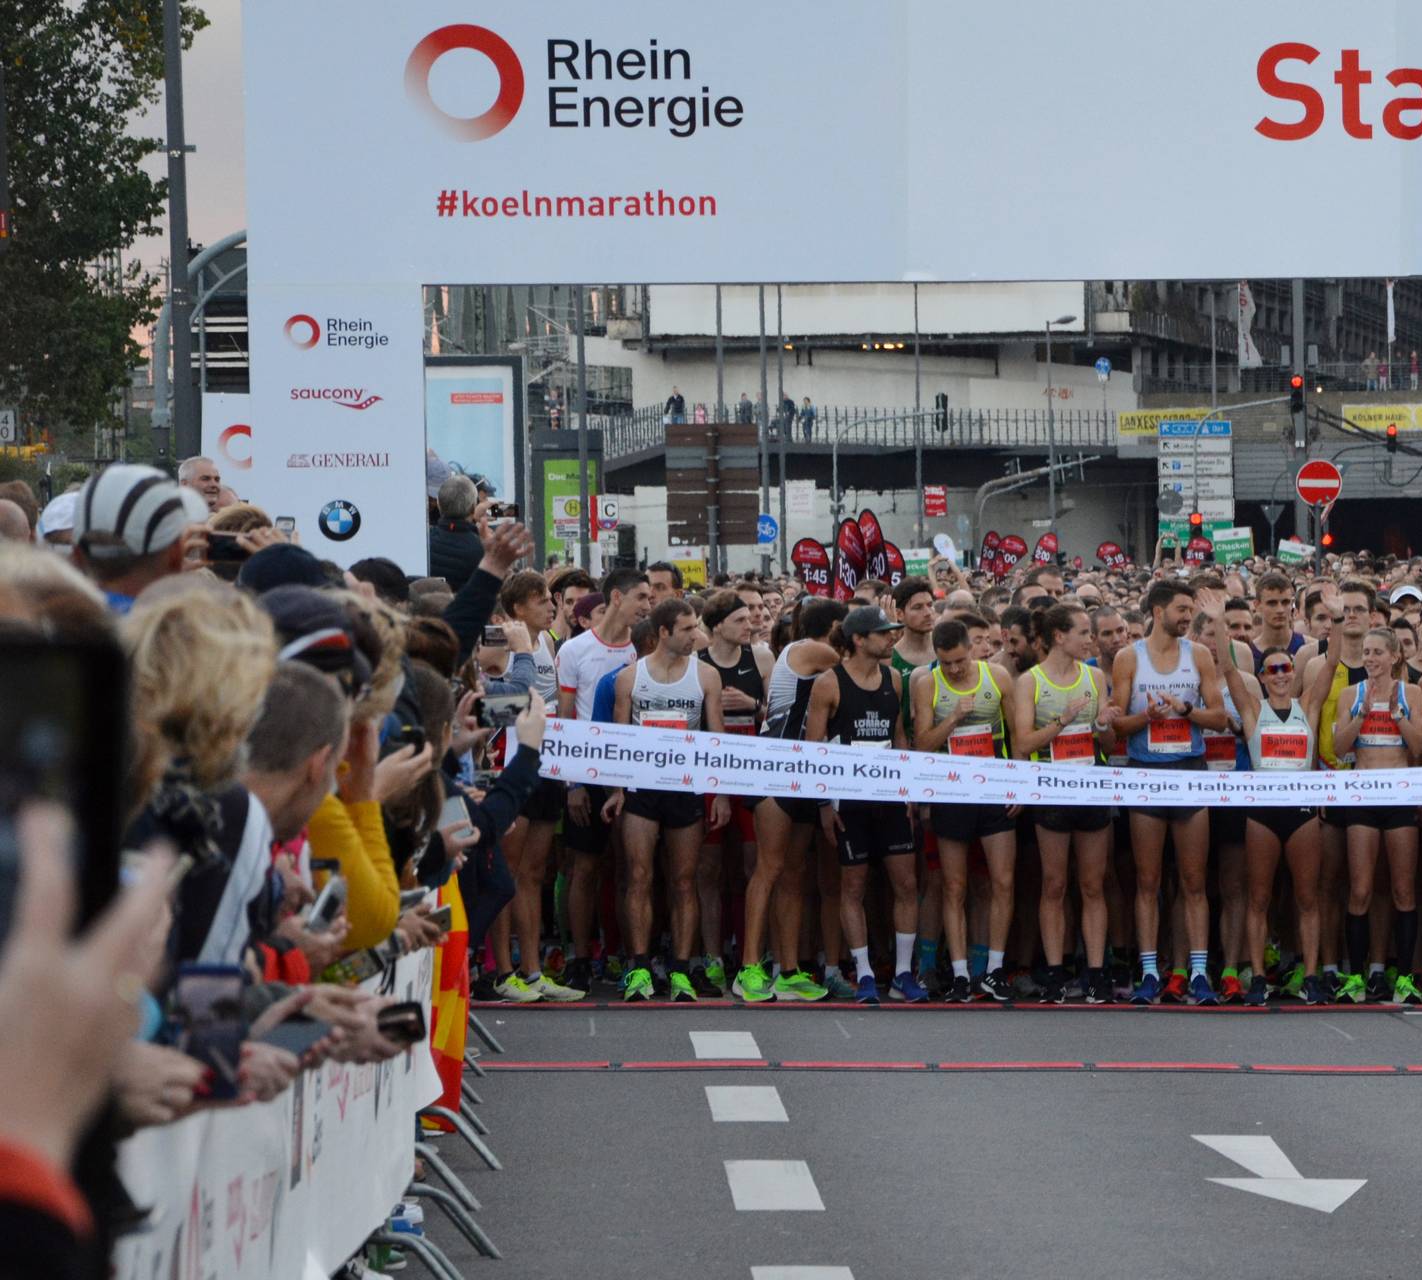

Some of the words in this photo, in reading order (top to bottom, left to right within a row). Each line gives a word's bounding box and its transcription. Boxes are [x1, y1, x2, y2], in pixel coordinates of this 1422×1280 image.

[548, 39, 691, 80] Rhein
[549, 87, 743, 137] Energie
[436, 189, 717, 217] #koelnmarathon
[327, 318, 373, 332] Rhein
[327, 333, 389, 350] Energie
[290, 388, 364, 402] saucony
[312, 453, 389, 467] GENERALI
[605, 503, 616, 517] C
[803, 569, 828, 584] 1:45
[640, 700, 649, 710] LT
[668, 700, 695, 709] DSHS
[1267, 735, 1304, 746] Sabrina
[541, 739, 686, 767] RheinEnergie
[694, 751, 844, 776] Halbmarathon
[852, 763, 900, 779] Köln
[1038, 776, 1179, 792] RheinEnergie
[1188, 779, 1336, 791] Halbmarathon
[1345, 778, 1392, 790] Köln
